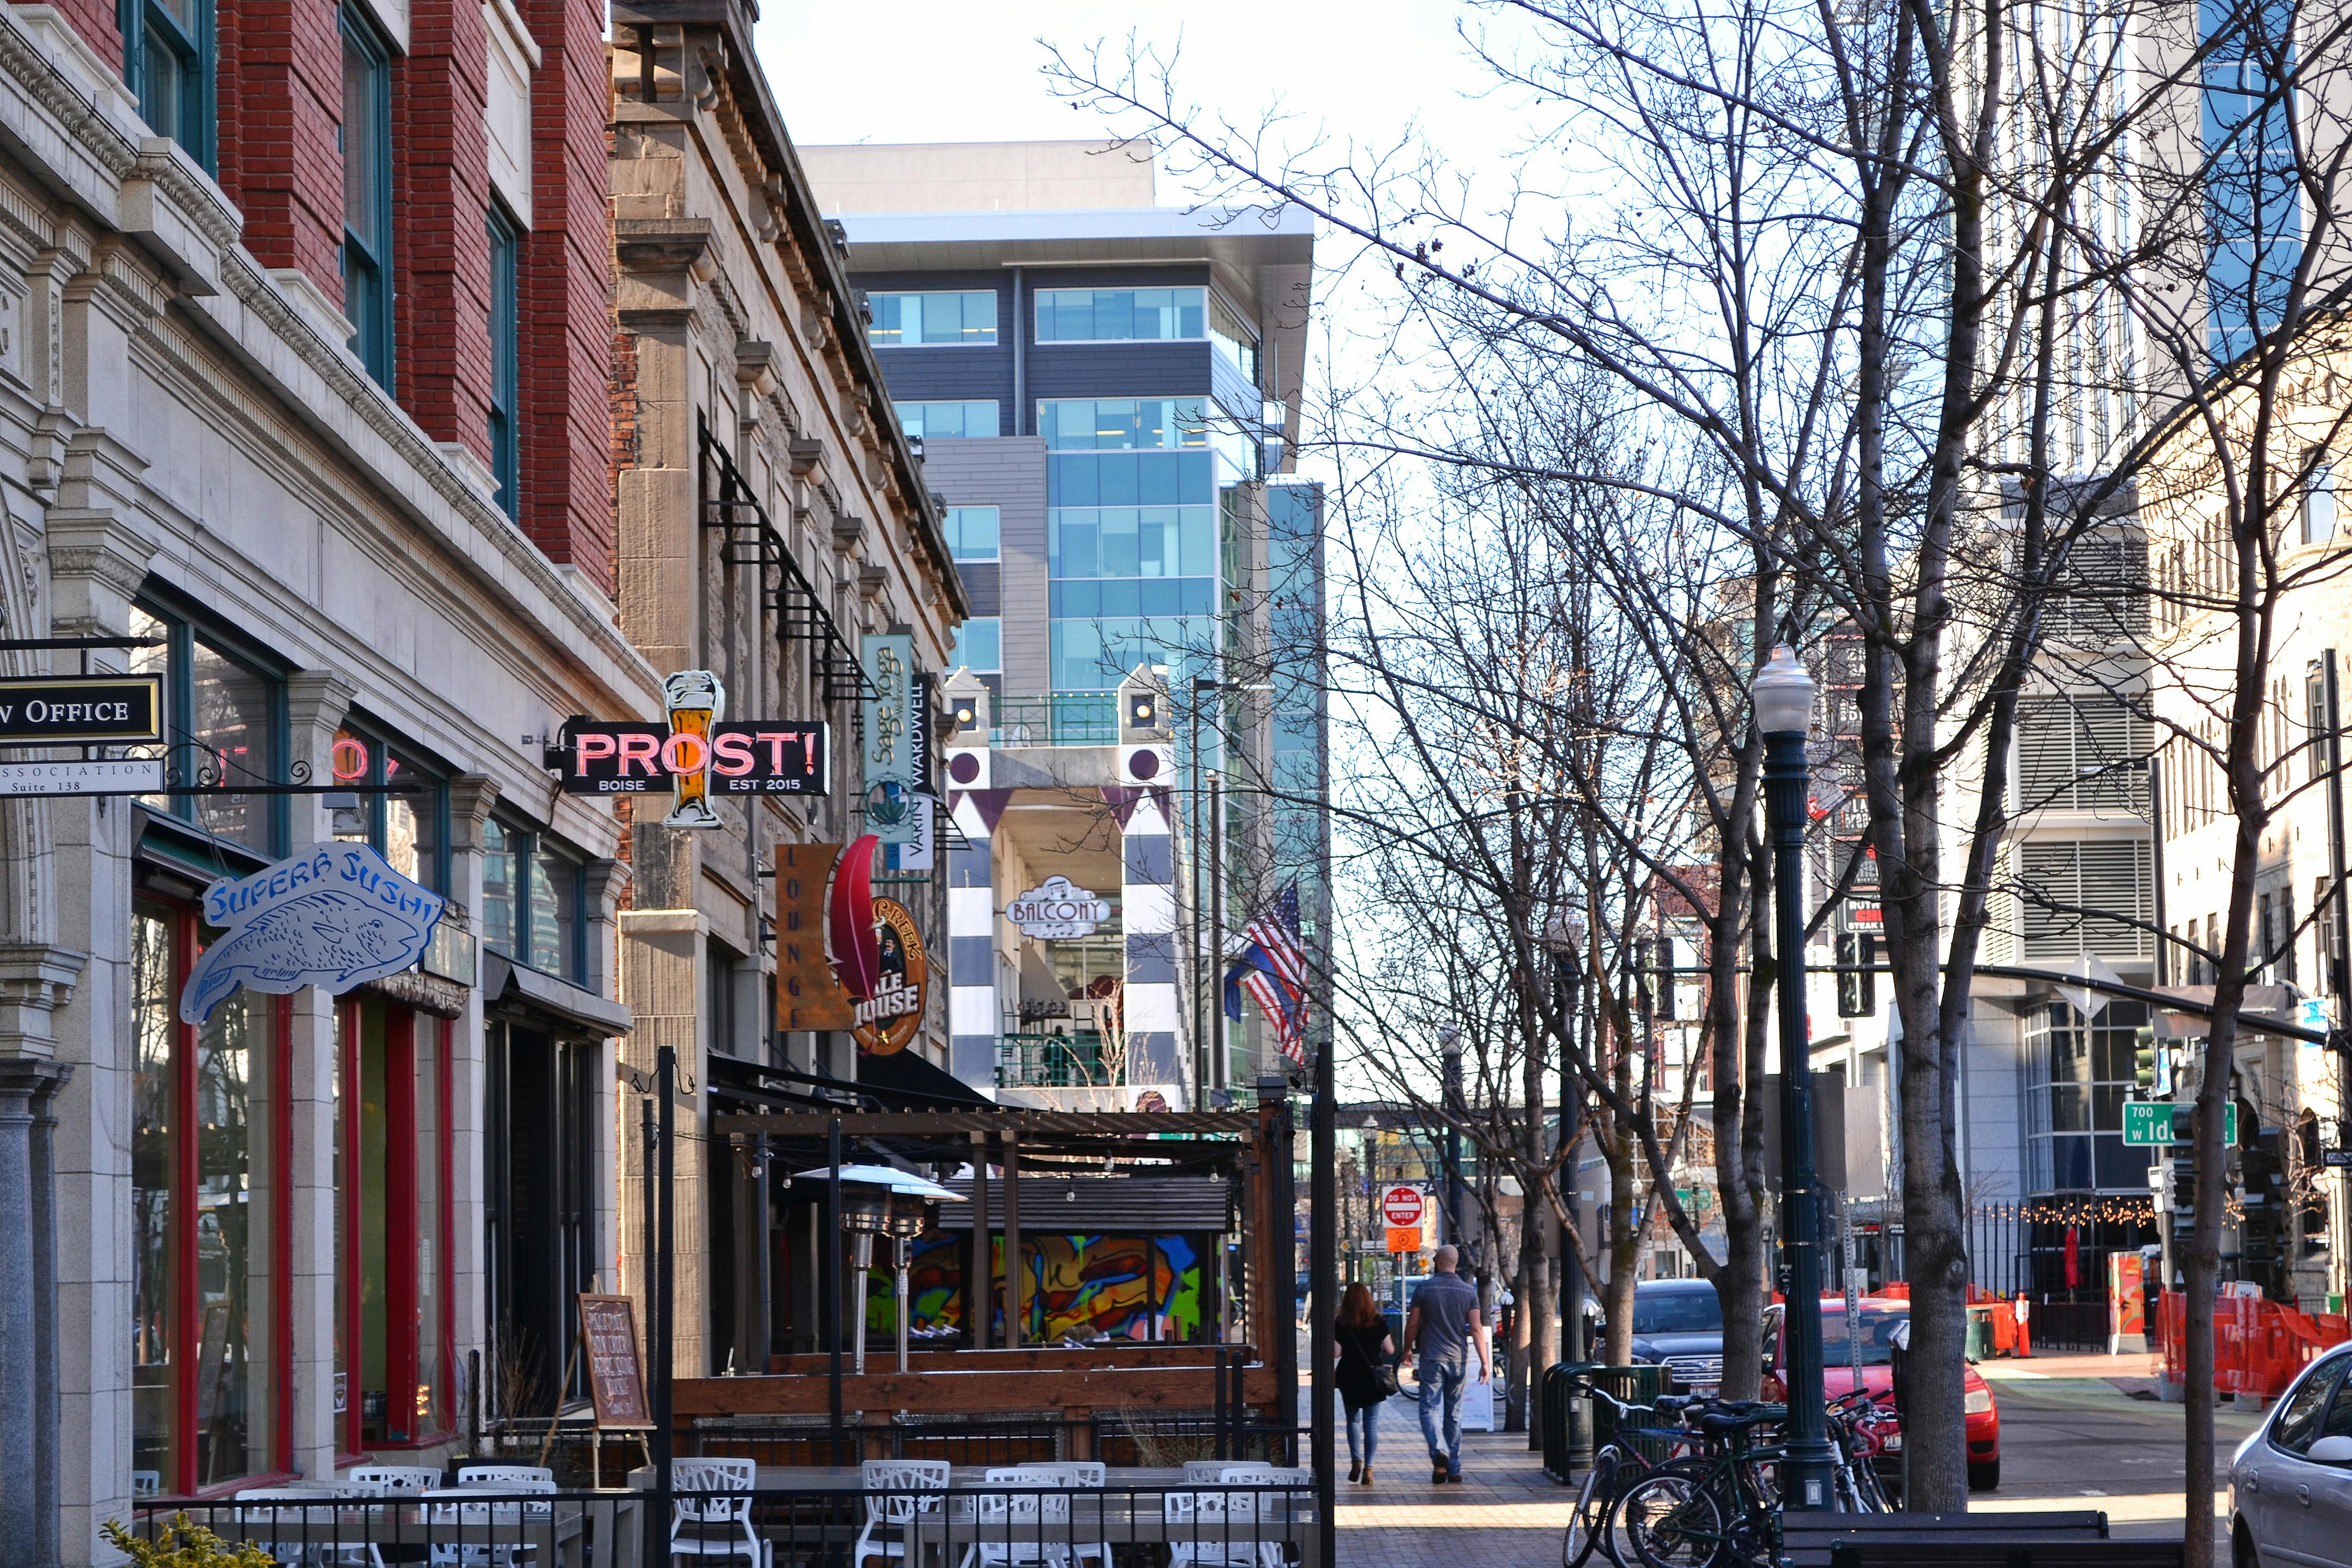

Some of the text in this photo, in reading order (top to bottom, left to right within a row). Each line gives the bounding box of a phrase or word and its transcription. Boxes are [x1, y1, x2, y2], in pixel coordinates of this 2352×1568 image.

[26, 700, 128, 723] OFFICE
[872, 647, 903, 766] Sage Yoga
[911, 682, 923, 786] WARDWELL
[574, 732, 817, 776] PROST!
[12, 782, 80, 792] Suite 138
[599, 780, 646, 791] BOISE
[729, 779, 801, 790] EST 2015
[210, 852, 432, 922] SUPERB SUSHI
[1014, 902, 1101, 921] BALCONY
[787, 847, 800, 1028] LOUNGE
[874, 899, 922, 960] CREEK
[2132, 1107, 2153, 1118] 700
